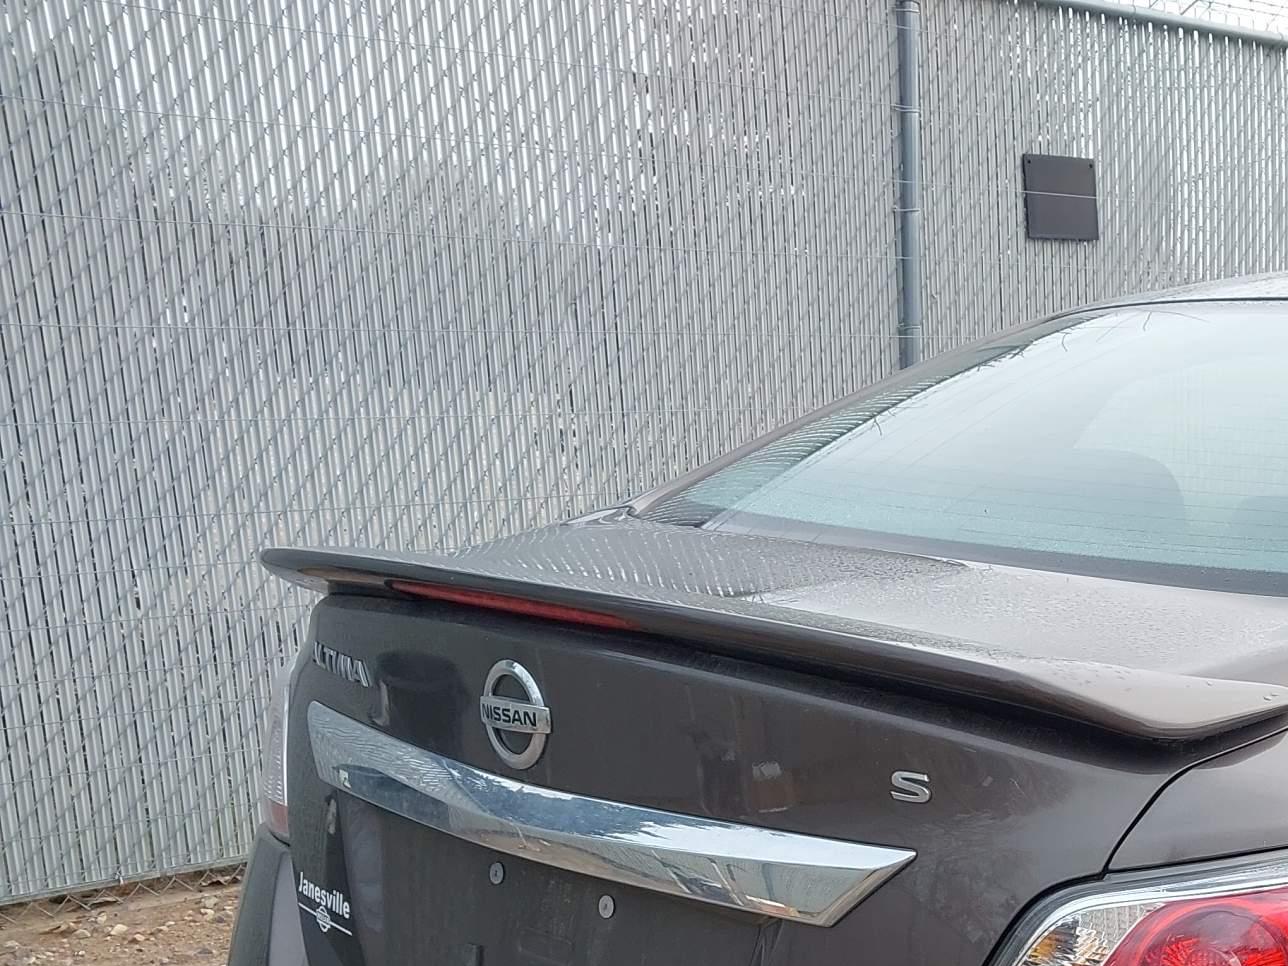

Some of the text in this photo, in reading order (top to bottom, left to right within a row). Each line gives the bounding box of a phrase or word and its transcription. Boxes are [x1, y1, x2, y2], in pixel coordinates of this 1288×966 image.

[481, 703, 537, 728] NISSAN
[890, 770, 930, 803] S
[298, 871, 351, 919] Janesville
